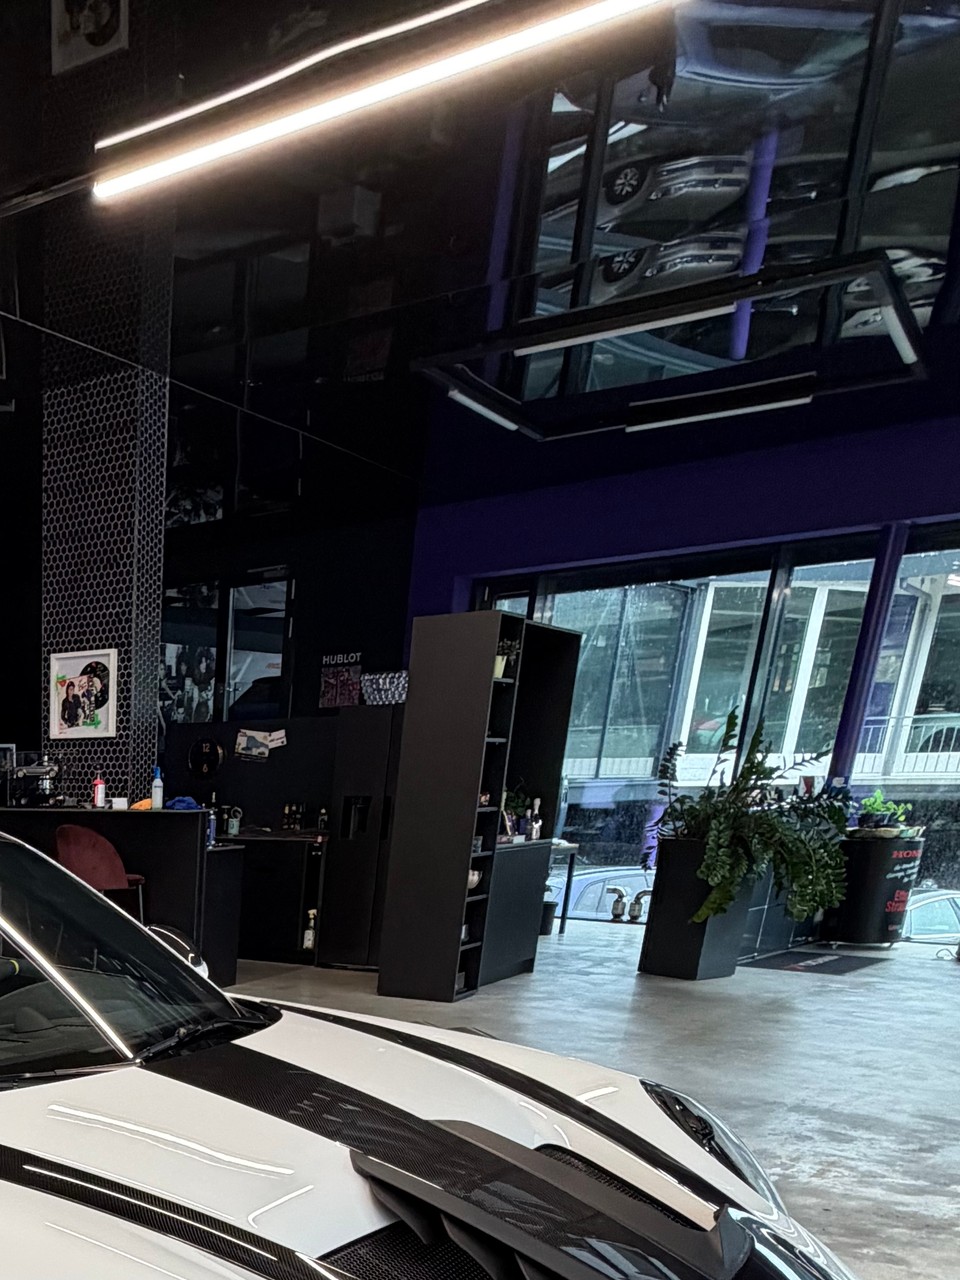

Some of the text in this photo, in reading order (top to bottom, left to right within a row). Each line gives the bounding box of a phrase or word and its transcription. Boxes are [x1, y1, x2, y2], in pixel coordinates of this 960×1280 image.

[322, 652, 362, 665] HUBLOT
[202, 743, 211, 753] 12
[202, 763, 209, 773] 6
